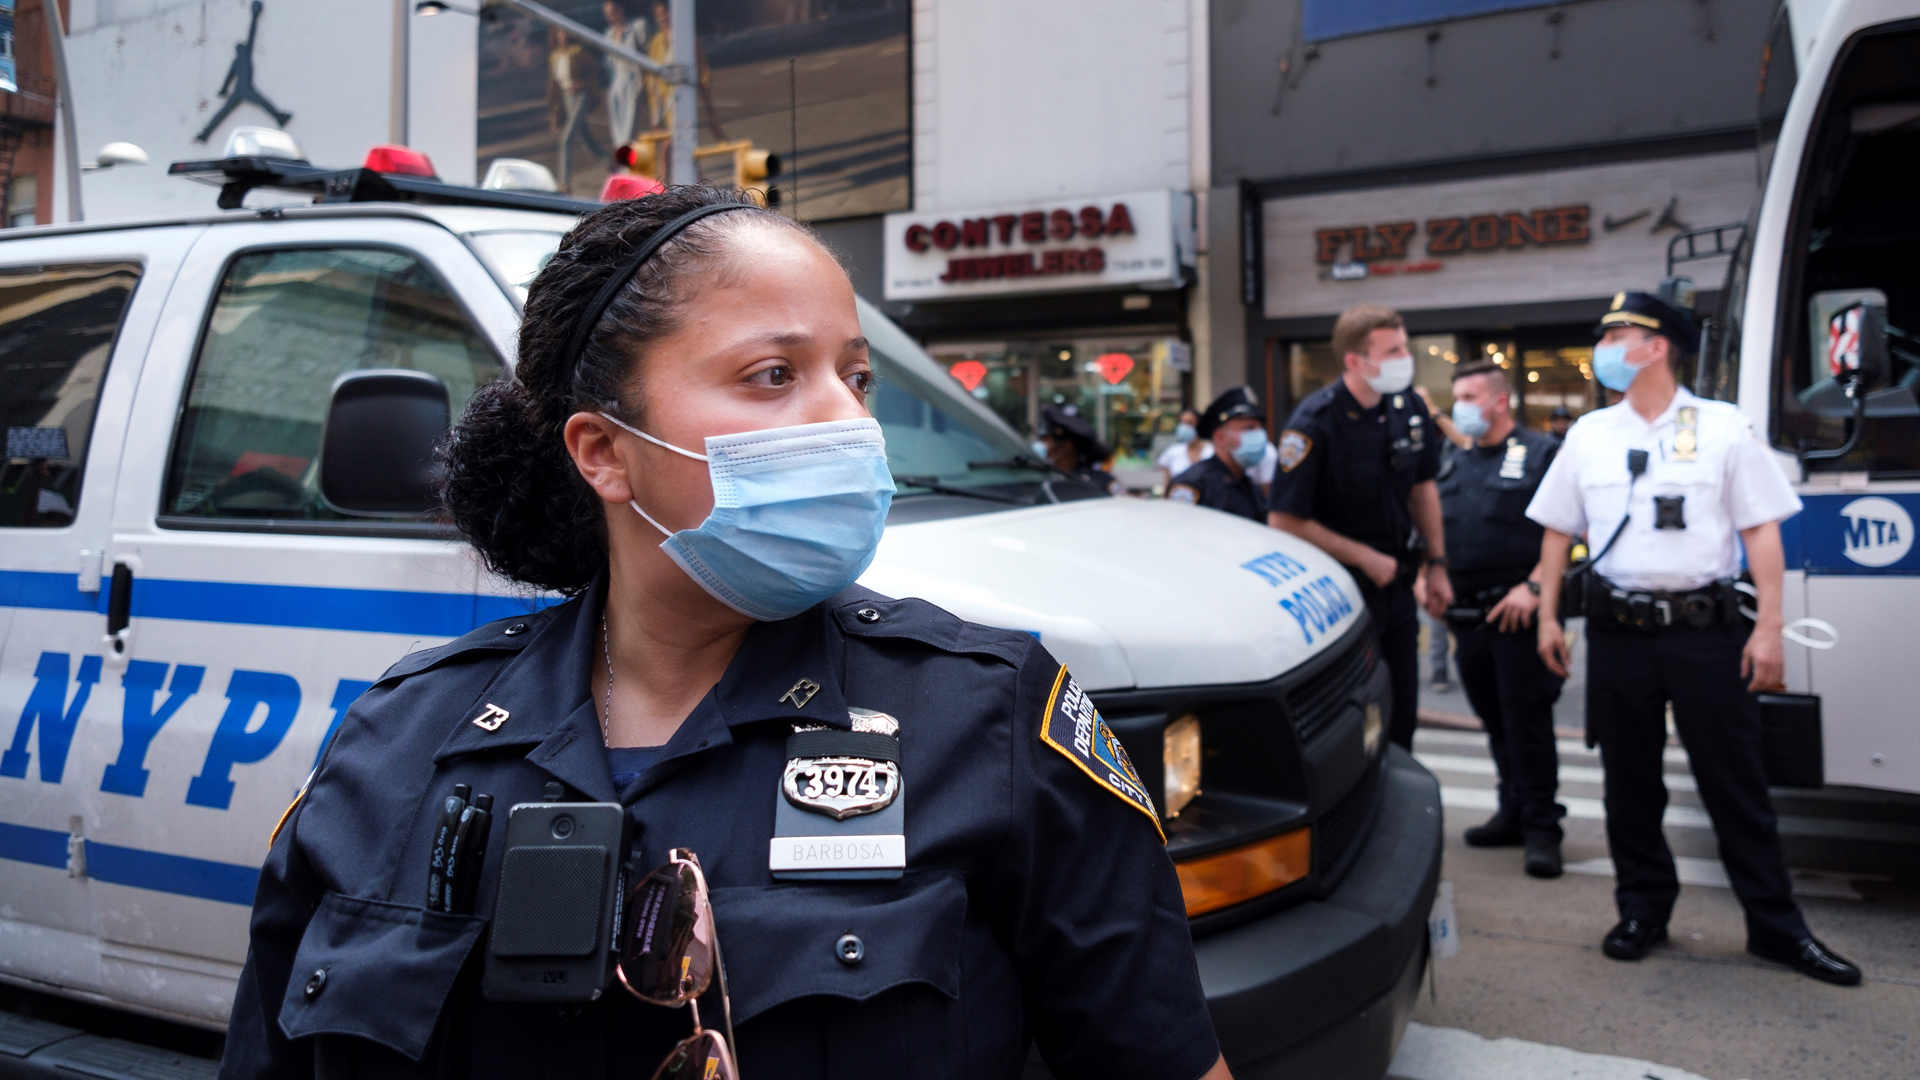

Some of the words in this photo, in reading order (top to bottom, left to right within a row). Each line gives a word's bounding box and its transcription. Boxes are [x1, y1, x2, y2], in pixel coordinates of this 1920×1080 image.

[905, 203, 1134, 253] CONTESSA
[1316, 221, 1416, 262] FLY
[1426, 204, 1590, 255] ZONE
[940, 247, 1105, 283] JEWELERS
[1839, 515, 1900, 549] MTA
[1240, 552, 1307, 587] NYPD
[1278, 575, 1352, 645] POLICE
[804, 765, 879, 799] 3974
[1108, 772, 1143, 803] CITY
[793, 843, 884, 861] BARBOSA
